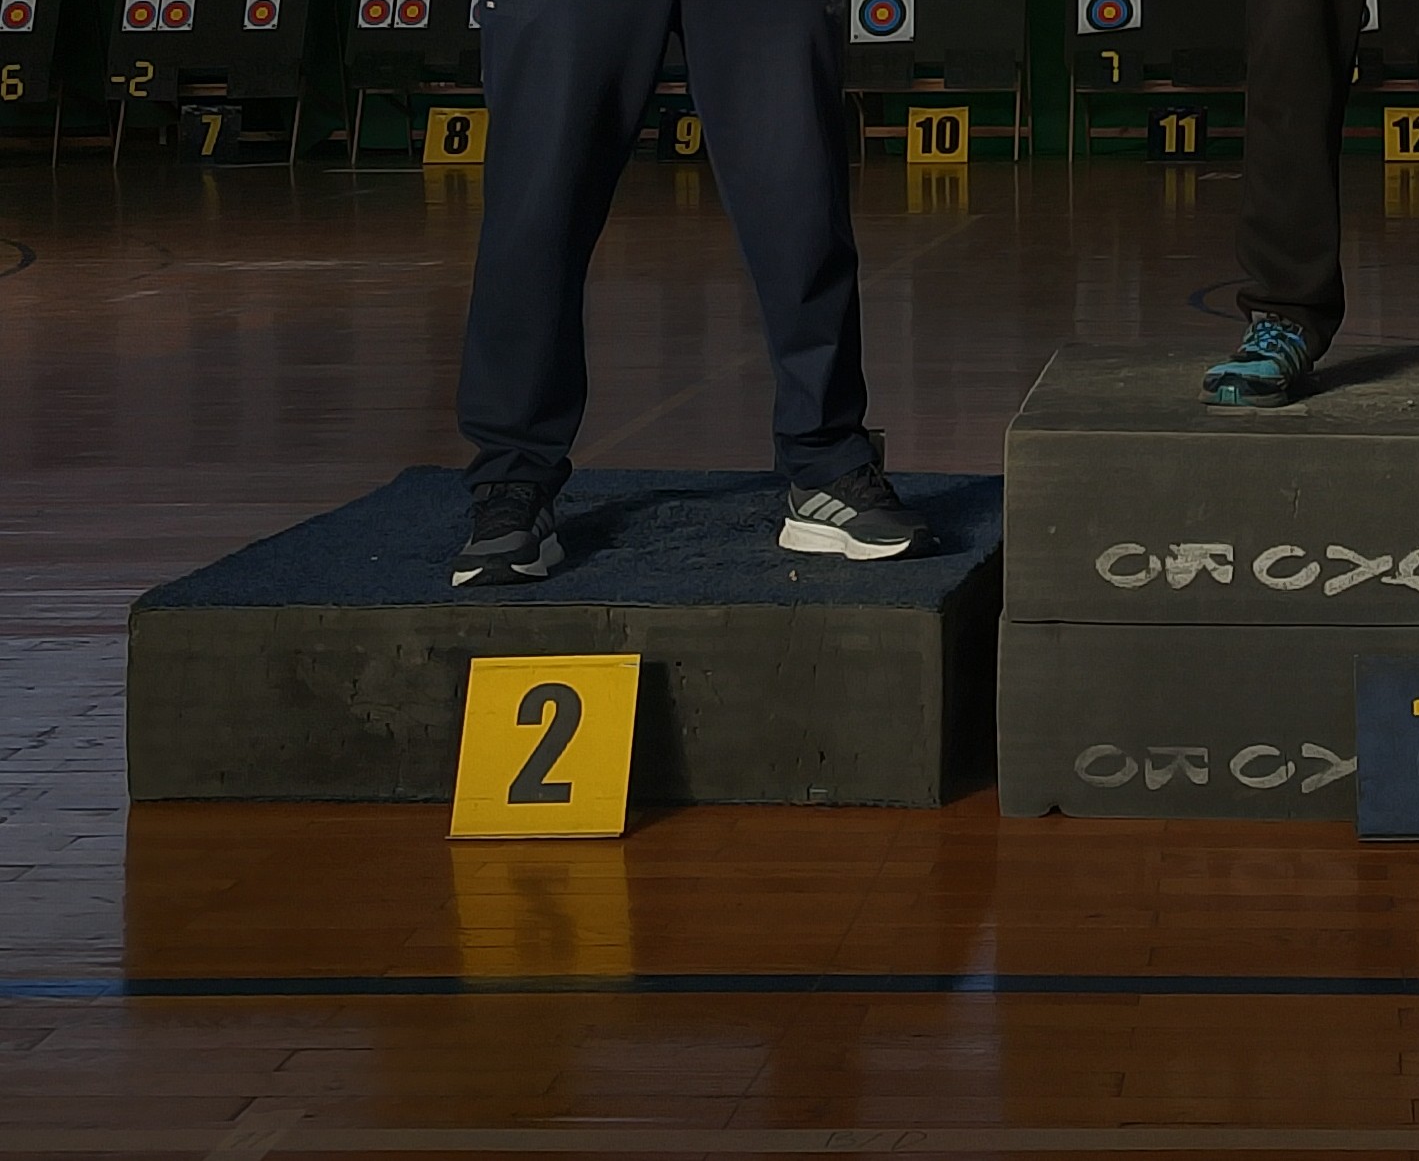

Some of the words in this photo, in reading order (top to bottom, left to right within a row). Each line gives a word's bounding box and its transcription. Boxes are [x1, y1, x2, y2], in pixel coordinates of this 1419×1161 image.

[1, 64, 24, 102] 6
[200, 114, 222, 157] 7
[442, 115, 473, 155] 8
[675, 117, 700, 155] 9
[915, 115, 961, 155] 10
[1159, 114, 1196, 153] 11
[506, 682, 584, 805] 2
